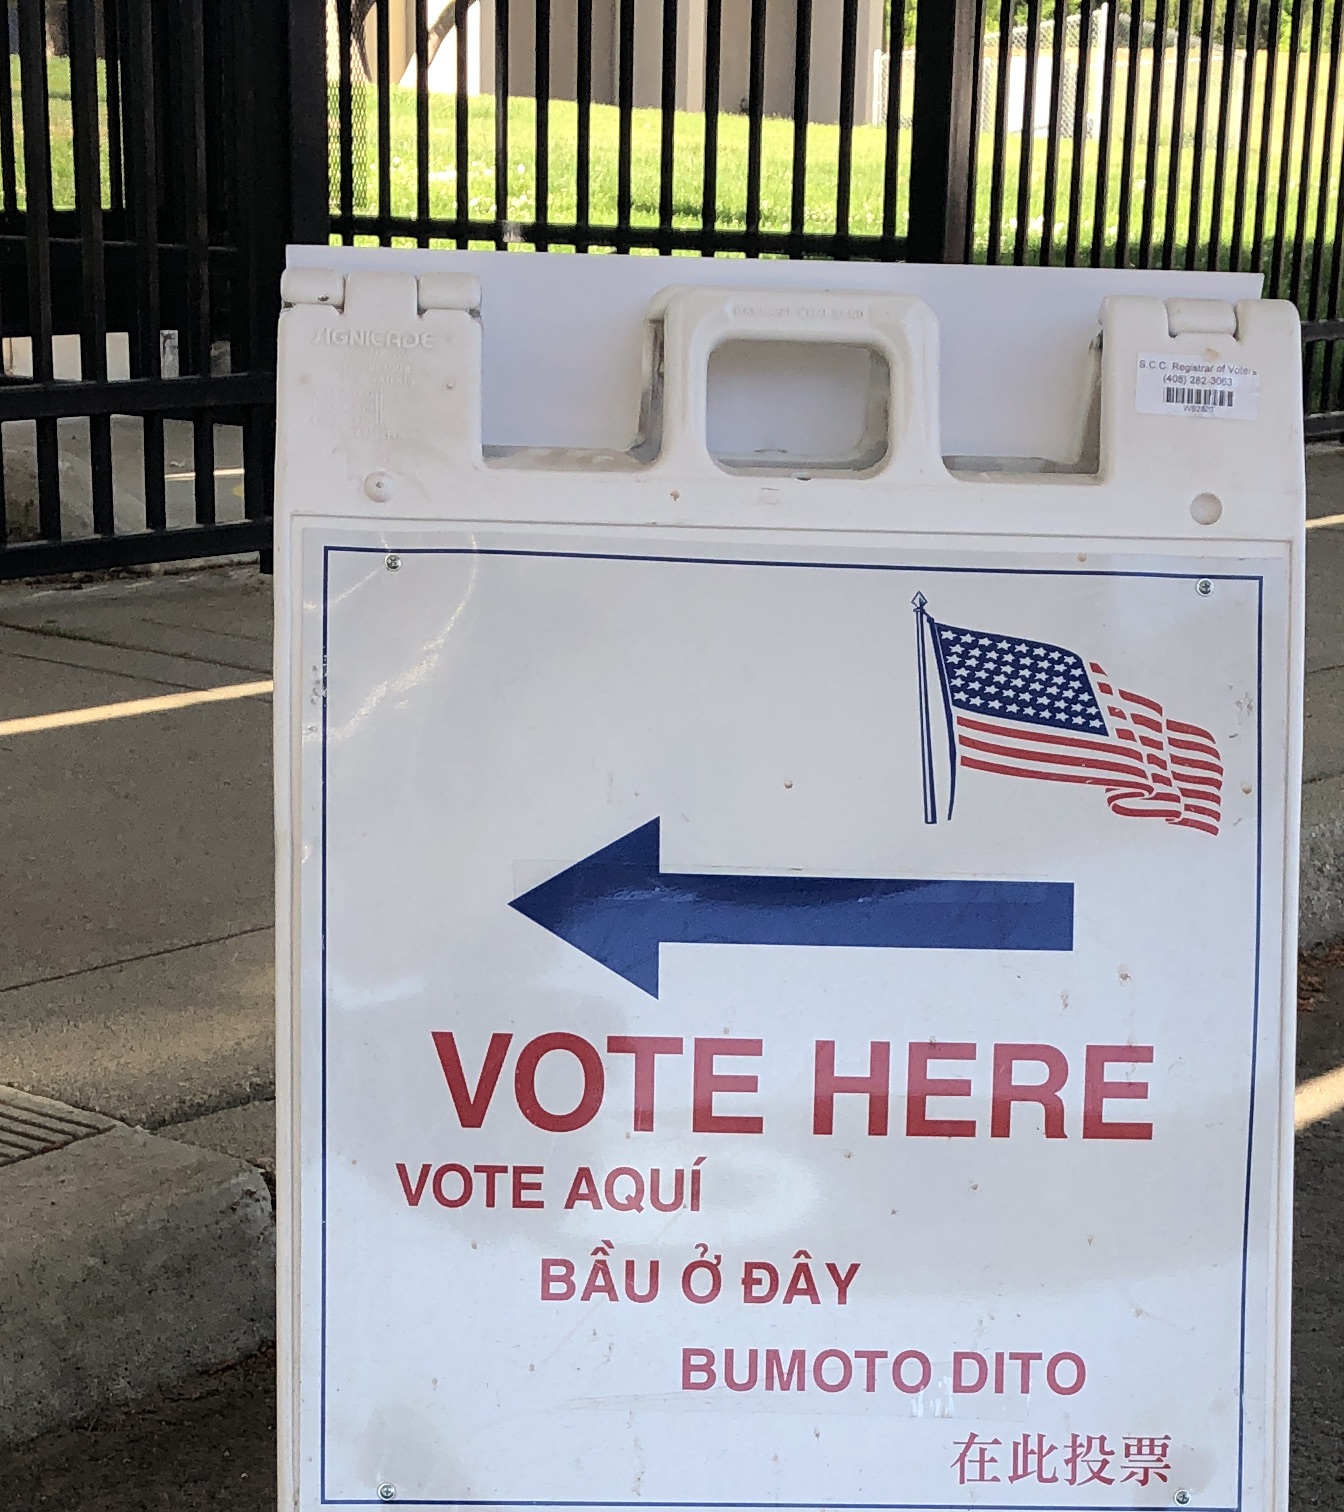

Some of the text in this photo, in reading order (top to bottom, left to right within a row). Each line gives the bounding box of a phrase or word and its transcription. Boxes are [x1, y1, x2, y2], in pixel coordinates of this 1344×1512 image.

[311, 327, 435, 349] SIGNICADE
[1163, 374, 1187, 385] (408)
[1172, 362, 1214, 374] Registrar
[1216, 364, 1226, 373] of
[431, 1030, 1154, 1141] VOTE HERE
[395, 1156, 708, 1214] VOTE AQUÍ
[540, 1239, 861, 1306] BẦU Ở ĐÂY
[682, 1348, 1087, 1395] BUMOTO DITO
[950, 1431, 1173, 1487] 在此投票
